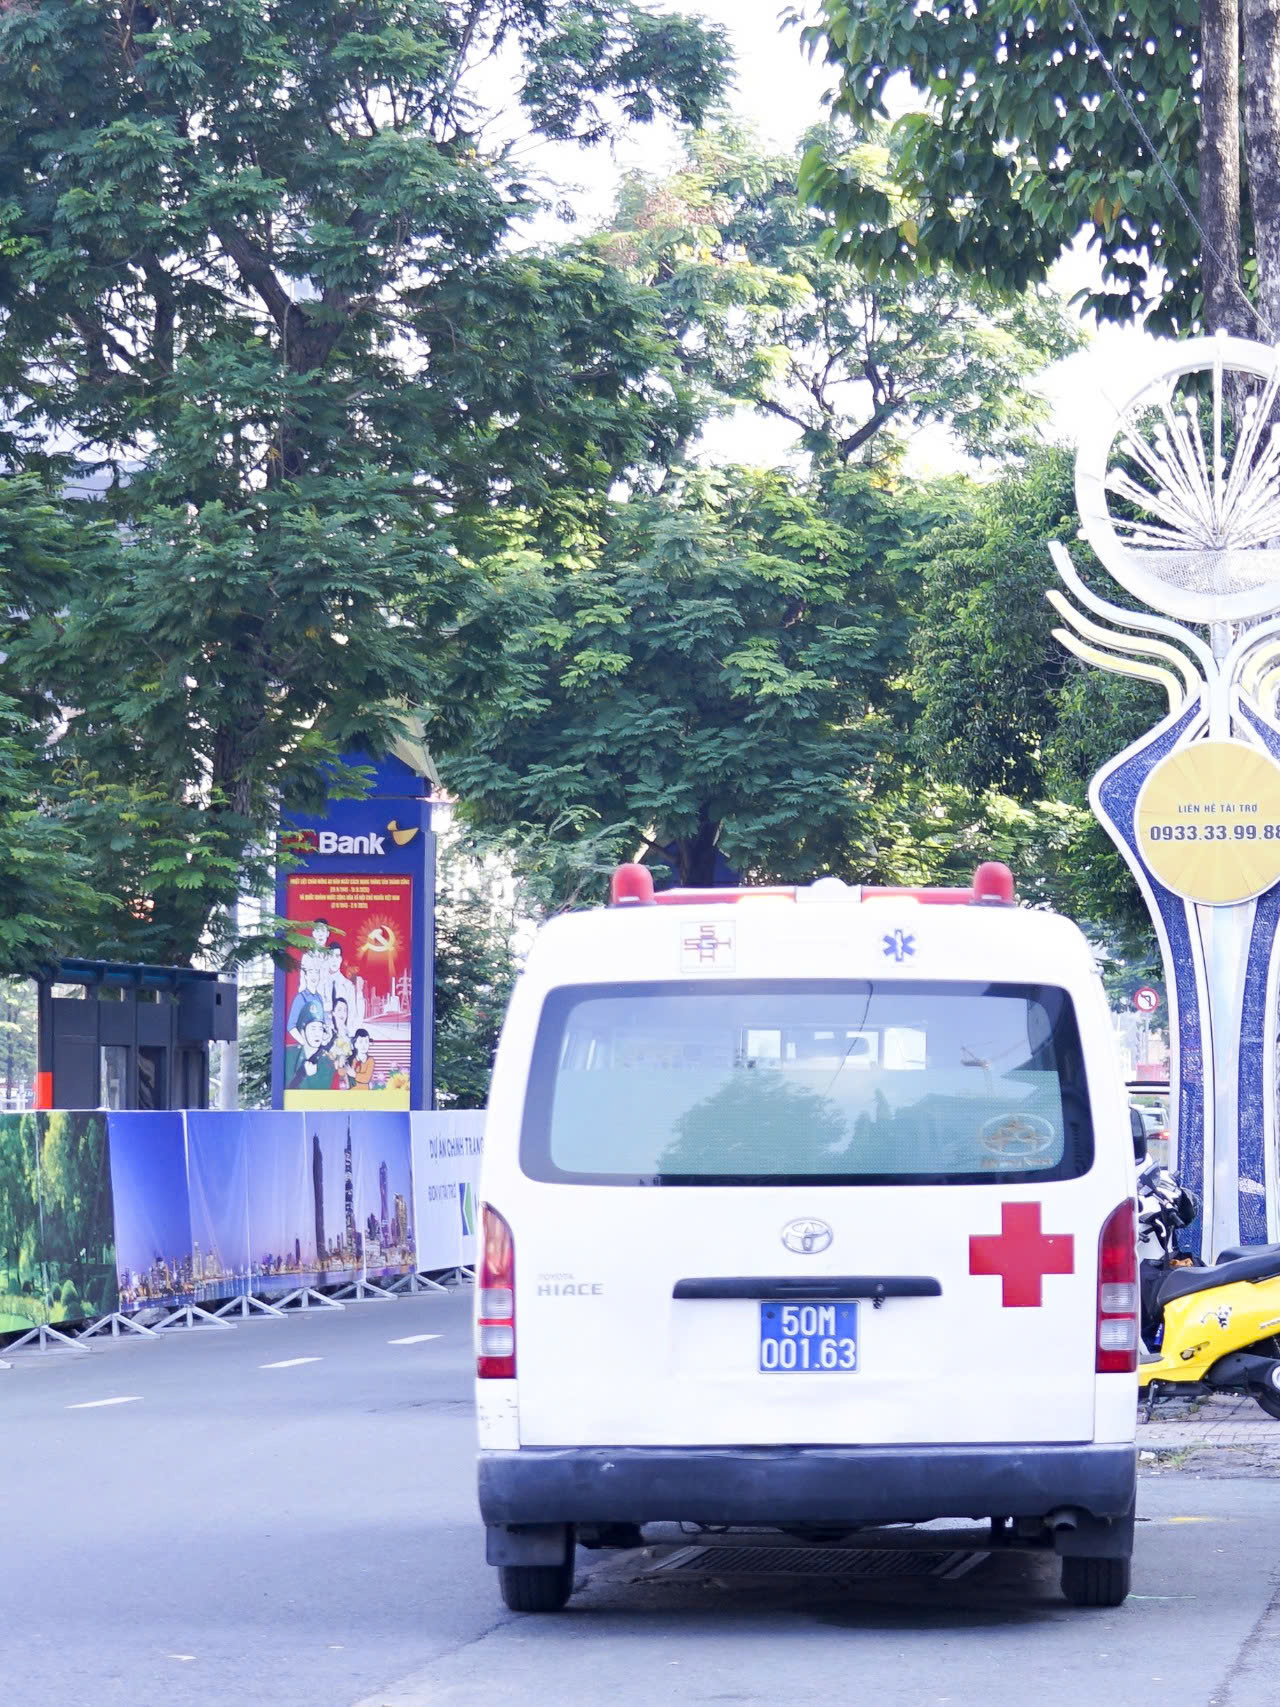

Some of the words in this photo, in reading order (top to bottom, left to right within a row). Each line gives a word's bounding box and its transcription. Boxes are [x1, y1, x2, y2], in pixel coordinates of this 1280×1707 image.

[1178, 803, 1201, 813] LIÊN
[1220, 803, 1235, 813] TÀI
[1239, 802, 1258, 814] TRỢ
[538, 1283, 604, 1297] HIACE
[781, 1305, 836, 1337] 50M
[761, 1338, 857, 1370] 001.63
